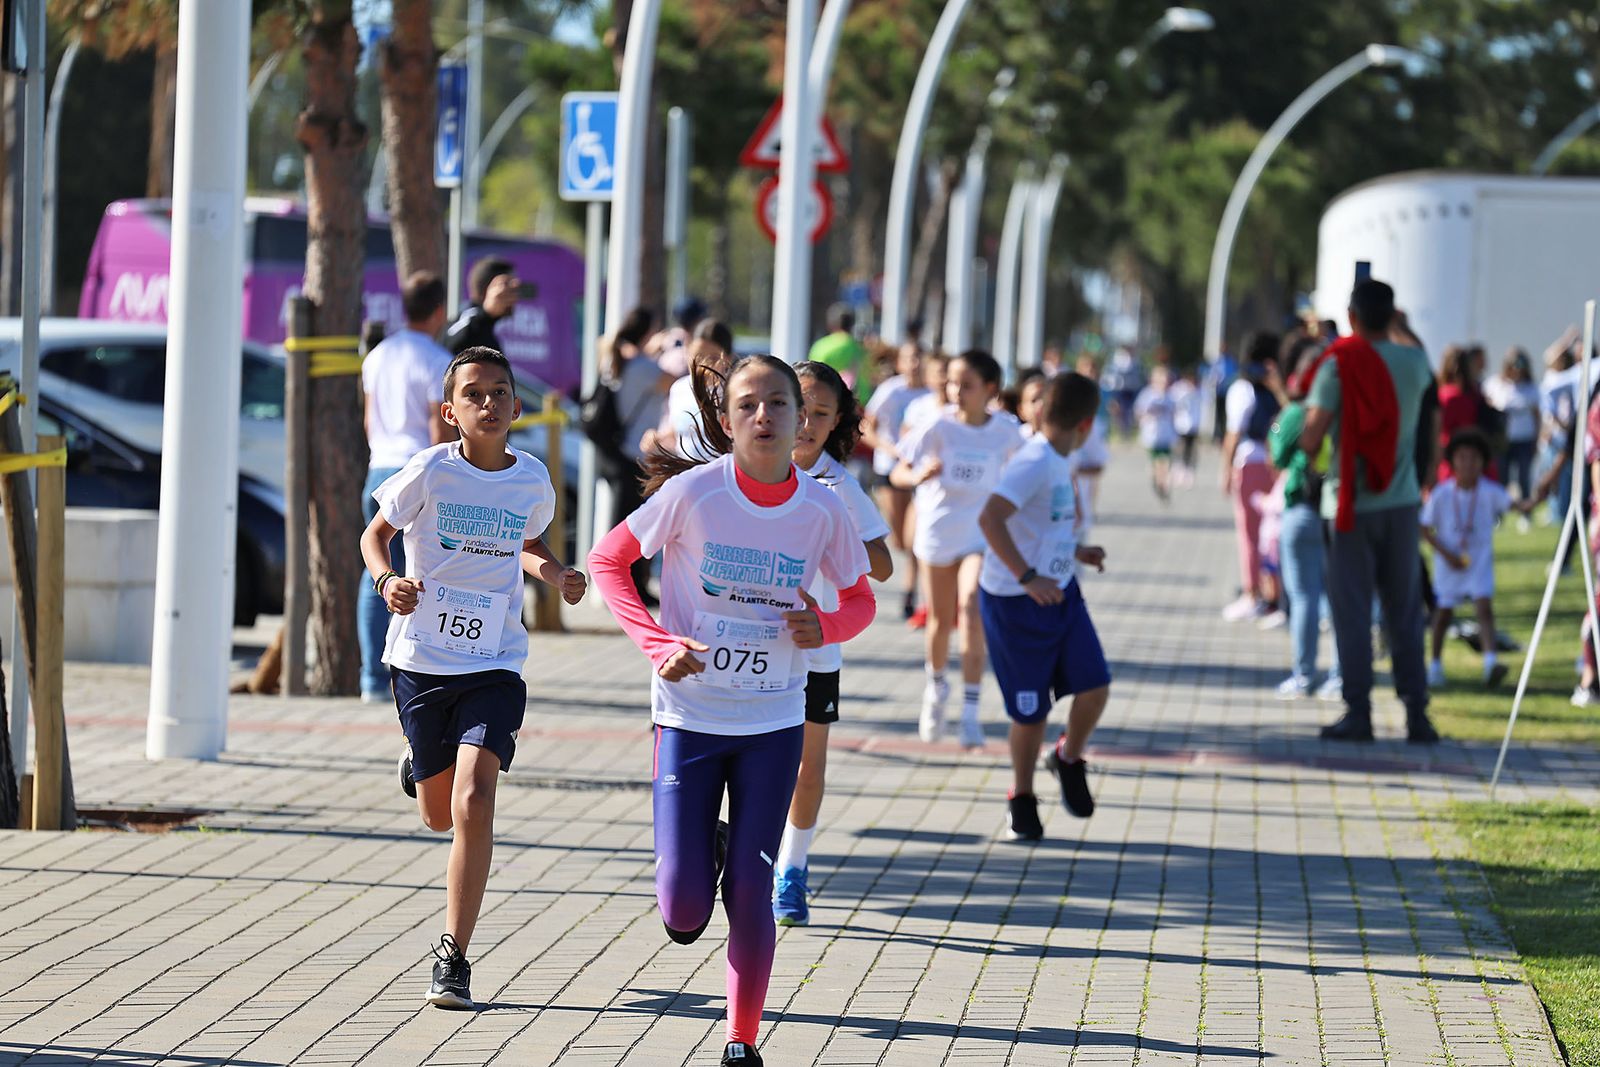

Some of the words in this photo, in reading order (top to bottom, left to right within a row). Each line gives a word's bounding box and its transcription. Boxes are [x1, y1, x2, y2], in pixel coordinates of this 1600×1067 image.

[437, 502, 498, 522] CARRERA
[437, 516, 495, 538] INFANTIL
[503, 516, 526, 530] kilos
[500, 531, 507, 540] x
[509, 529, 522, 540] km
[461, 546, 495, 556] ATLANTIC
[703, 541, 771, 568] CARRERA
[700, 557, 768, 586] INFANTIL
[778, 561, 804, 576] kilos
[775, 577, 783, 588] x
[731, 585, 772, 598] Fundación
[729, 594, 769, 605] ATLANTIC
[438, 612, 483, 641] 158
[713, 647, 769, 675] 075
